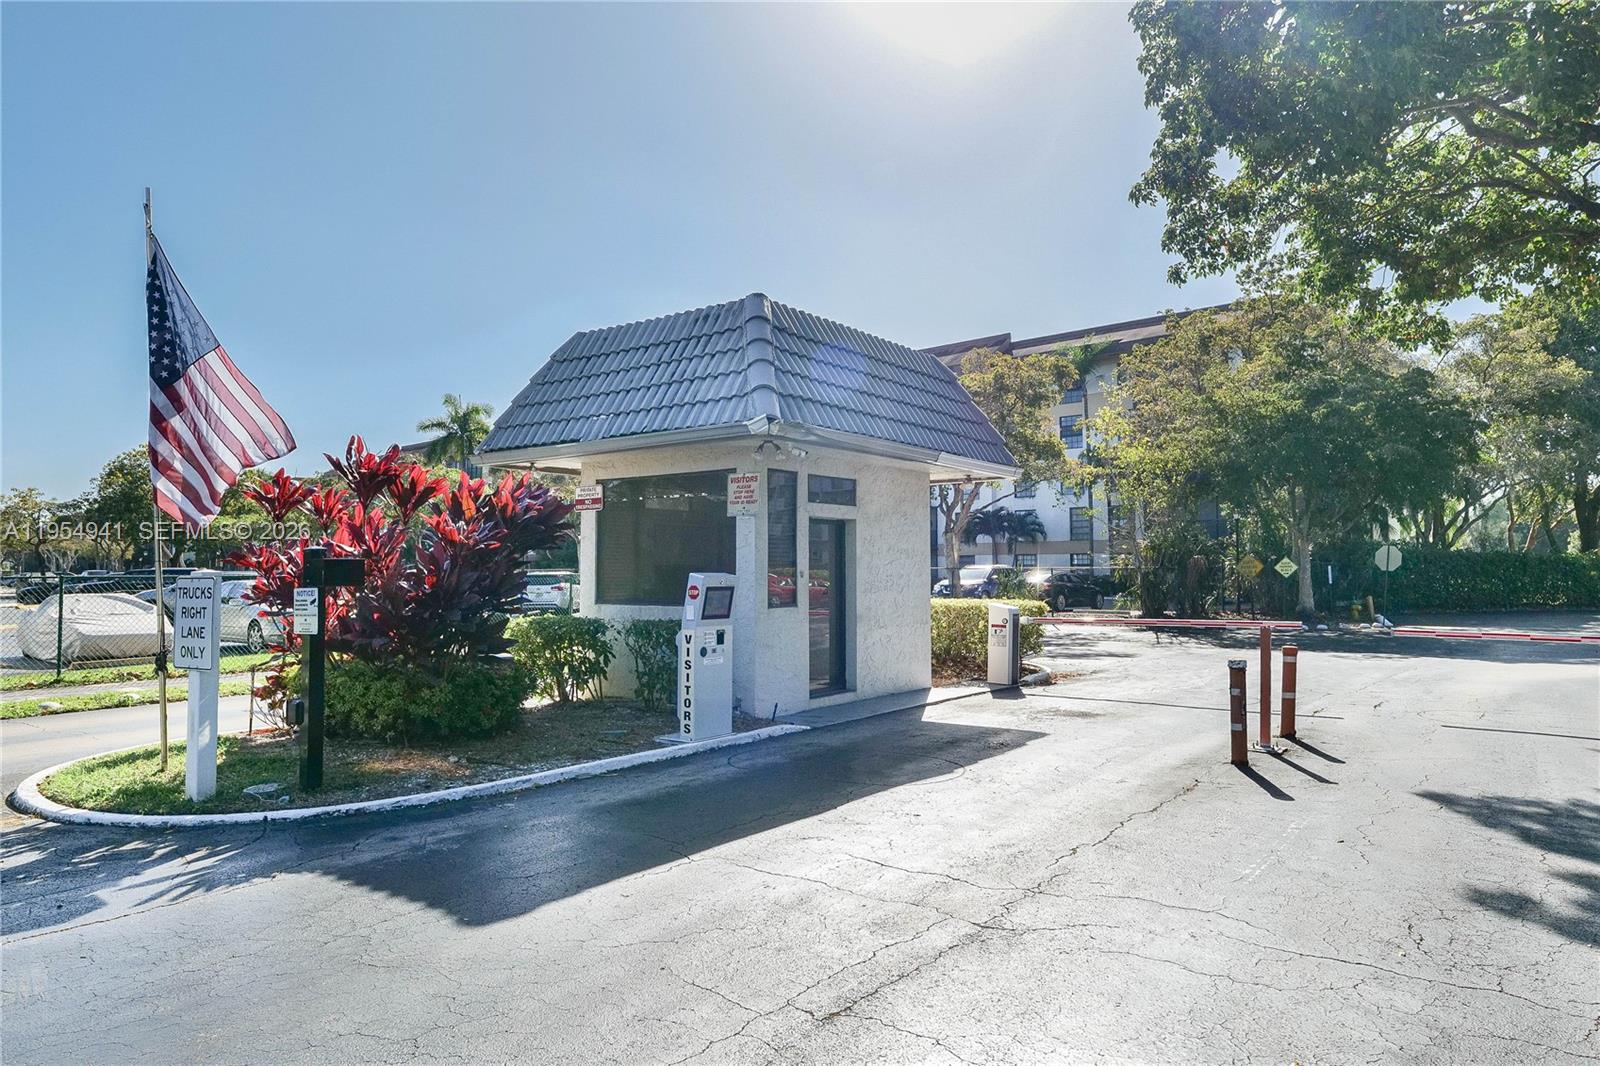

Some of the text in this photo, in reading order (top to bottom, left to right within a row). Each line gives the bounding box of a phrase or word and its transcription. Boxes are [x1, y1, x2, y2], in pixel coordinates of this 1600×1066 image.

[731, 475, 758, 484] VISITORS
[178, 587, 212, 599] TRUCKS
[181, 606, 207, 619] RIGHT
[181, 626, 206, 639] LANE
[180, 645, 206, 659] ONLY
[683, 634, 692, 734] VISITORS
